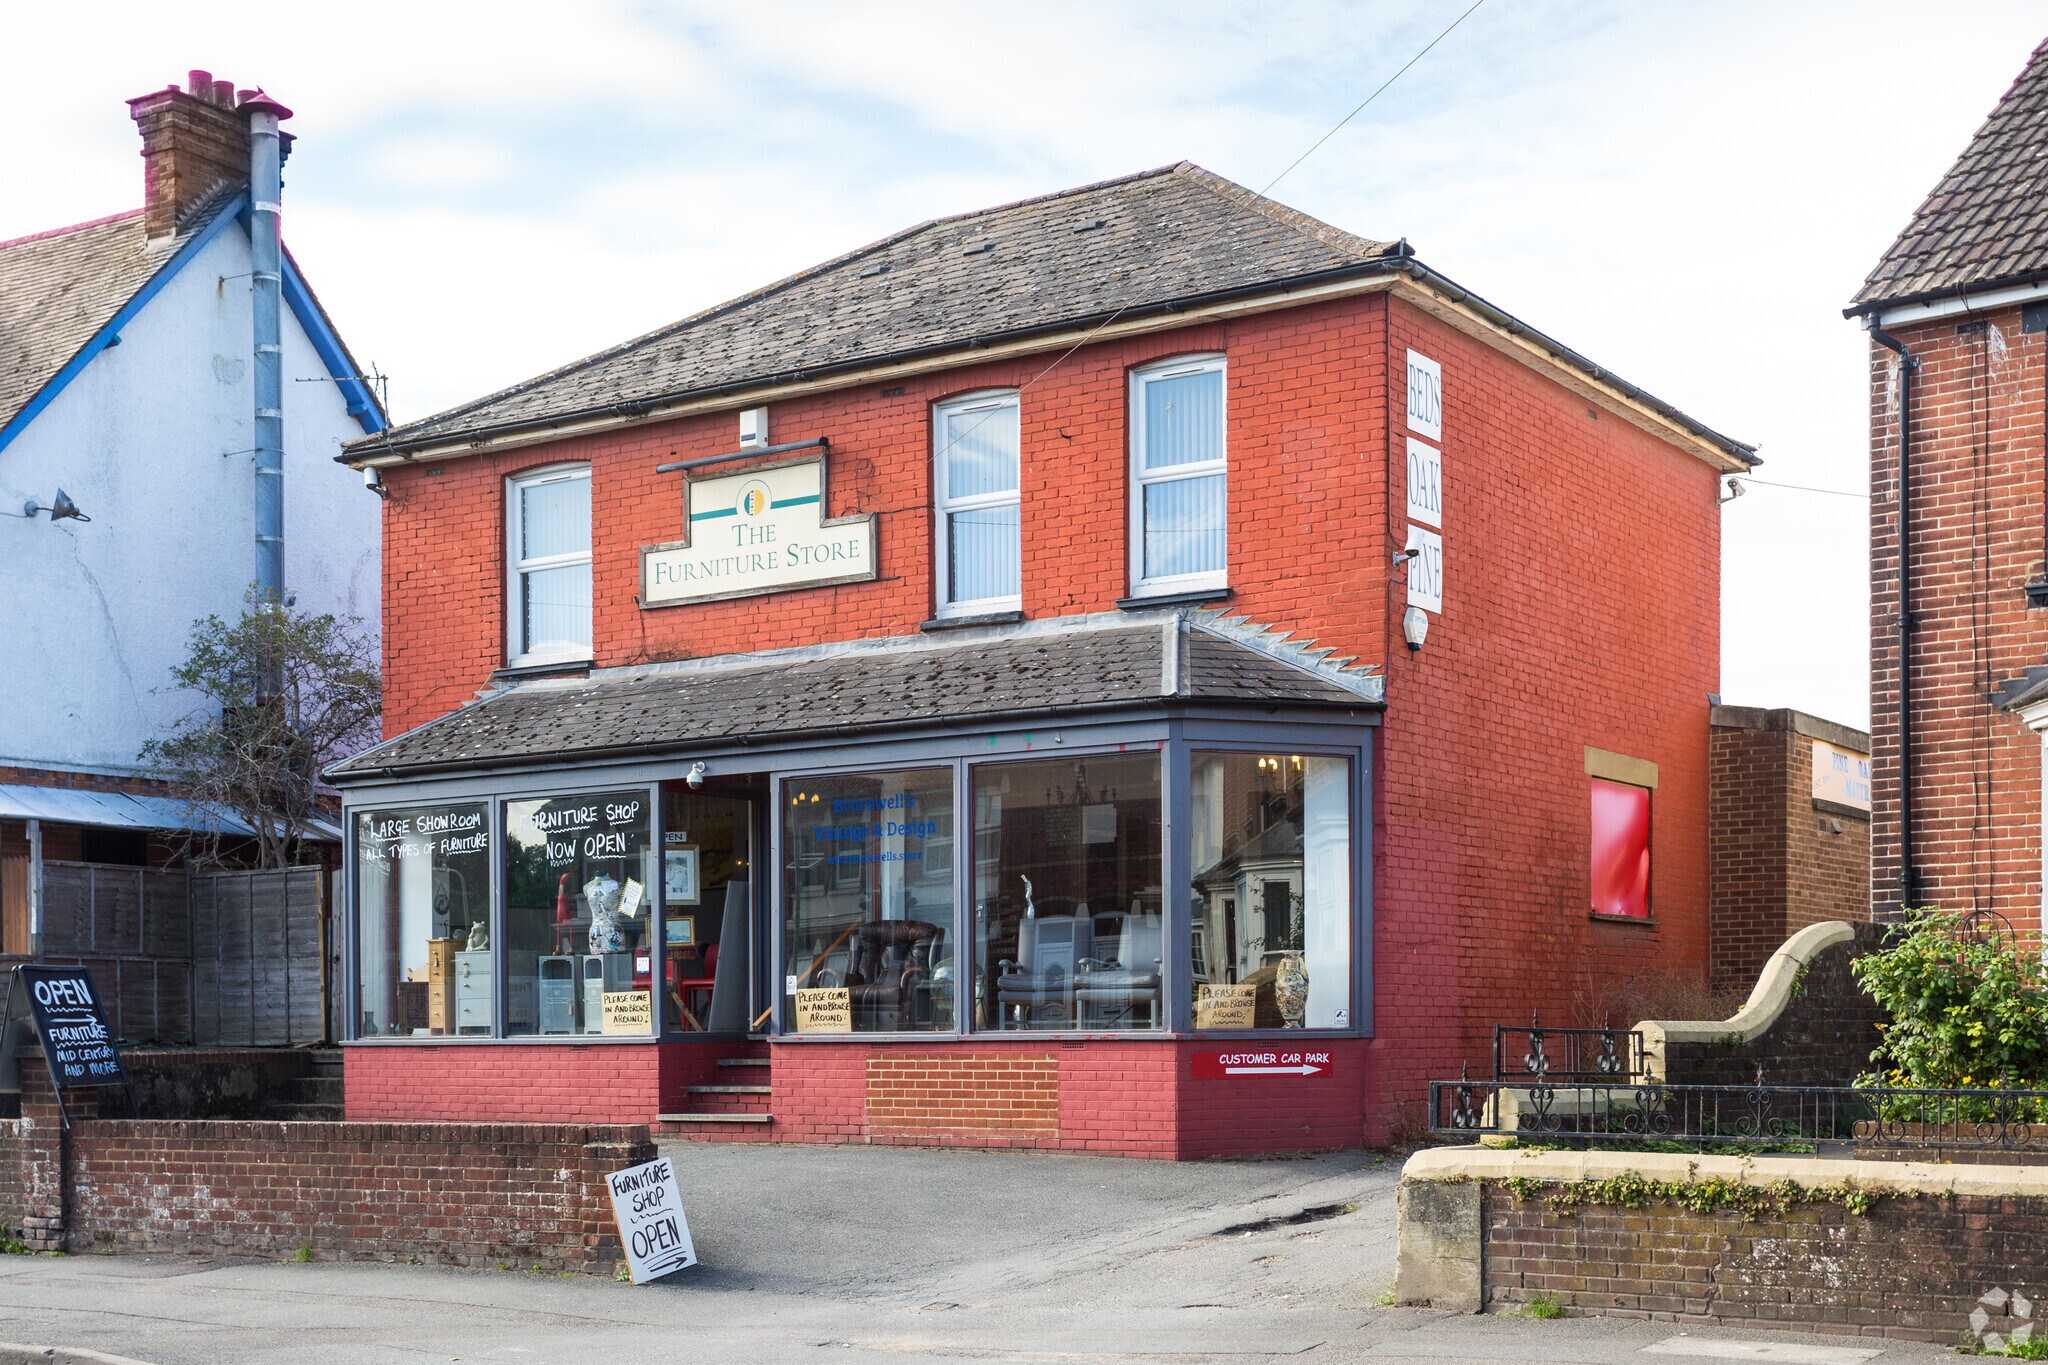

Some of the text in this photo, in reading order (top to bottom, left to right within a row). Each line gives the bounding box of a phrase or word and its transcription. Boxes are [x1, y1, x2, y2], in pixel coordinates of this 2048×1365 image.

[1409, 363, 1440, 428] BEDS
[1409, 452, 1440, 514] OAK
[732, 523, 777, 547] THE
[655, 540, 861, 585] FURNITURE STORE
[1832, 751, 1871, 779] PINE OA
[832, 792, 916, 813] Bracewell's
[370, 813, 481, 839] LARGE SHOWROOM
[519, 801, 640, 833] FURNITURE SHOP
[813, 820, 937, 843] Vintage & Design
[366, 832, 489, 860] ALL TYPES OF FURNITURE
[546, 840, 577, 860] NOW
[34, 978, 94, 1006] OPEN
[603, 994, 648, 1005] PLEASE COME
[798, 991, 848, 1003] PLEASE COME
[1203, 986, 1255, 999] PLEASE COME
[799, 1004, 809, 1012] IN
[1202, 999, 1255, 1010] IN AND BROWSE
[48, 1025, 109, 1042] FURNITURE
[56, 1045, 115, 1062] MID CENTURY
[1219, 1052, 1330, 1065] CUSTOMER CAR PARK
[64, 1061, 120, 1077] AND MORE
[611, 1162, 671, 1197] FURNITURE
[632, 1186, 665, 1213] SHOP
[631, 1215, 681, 1259] OPEN
